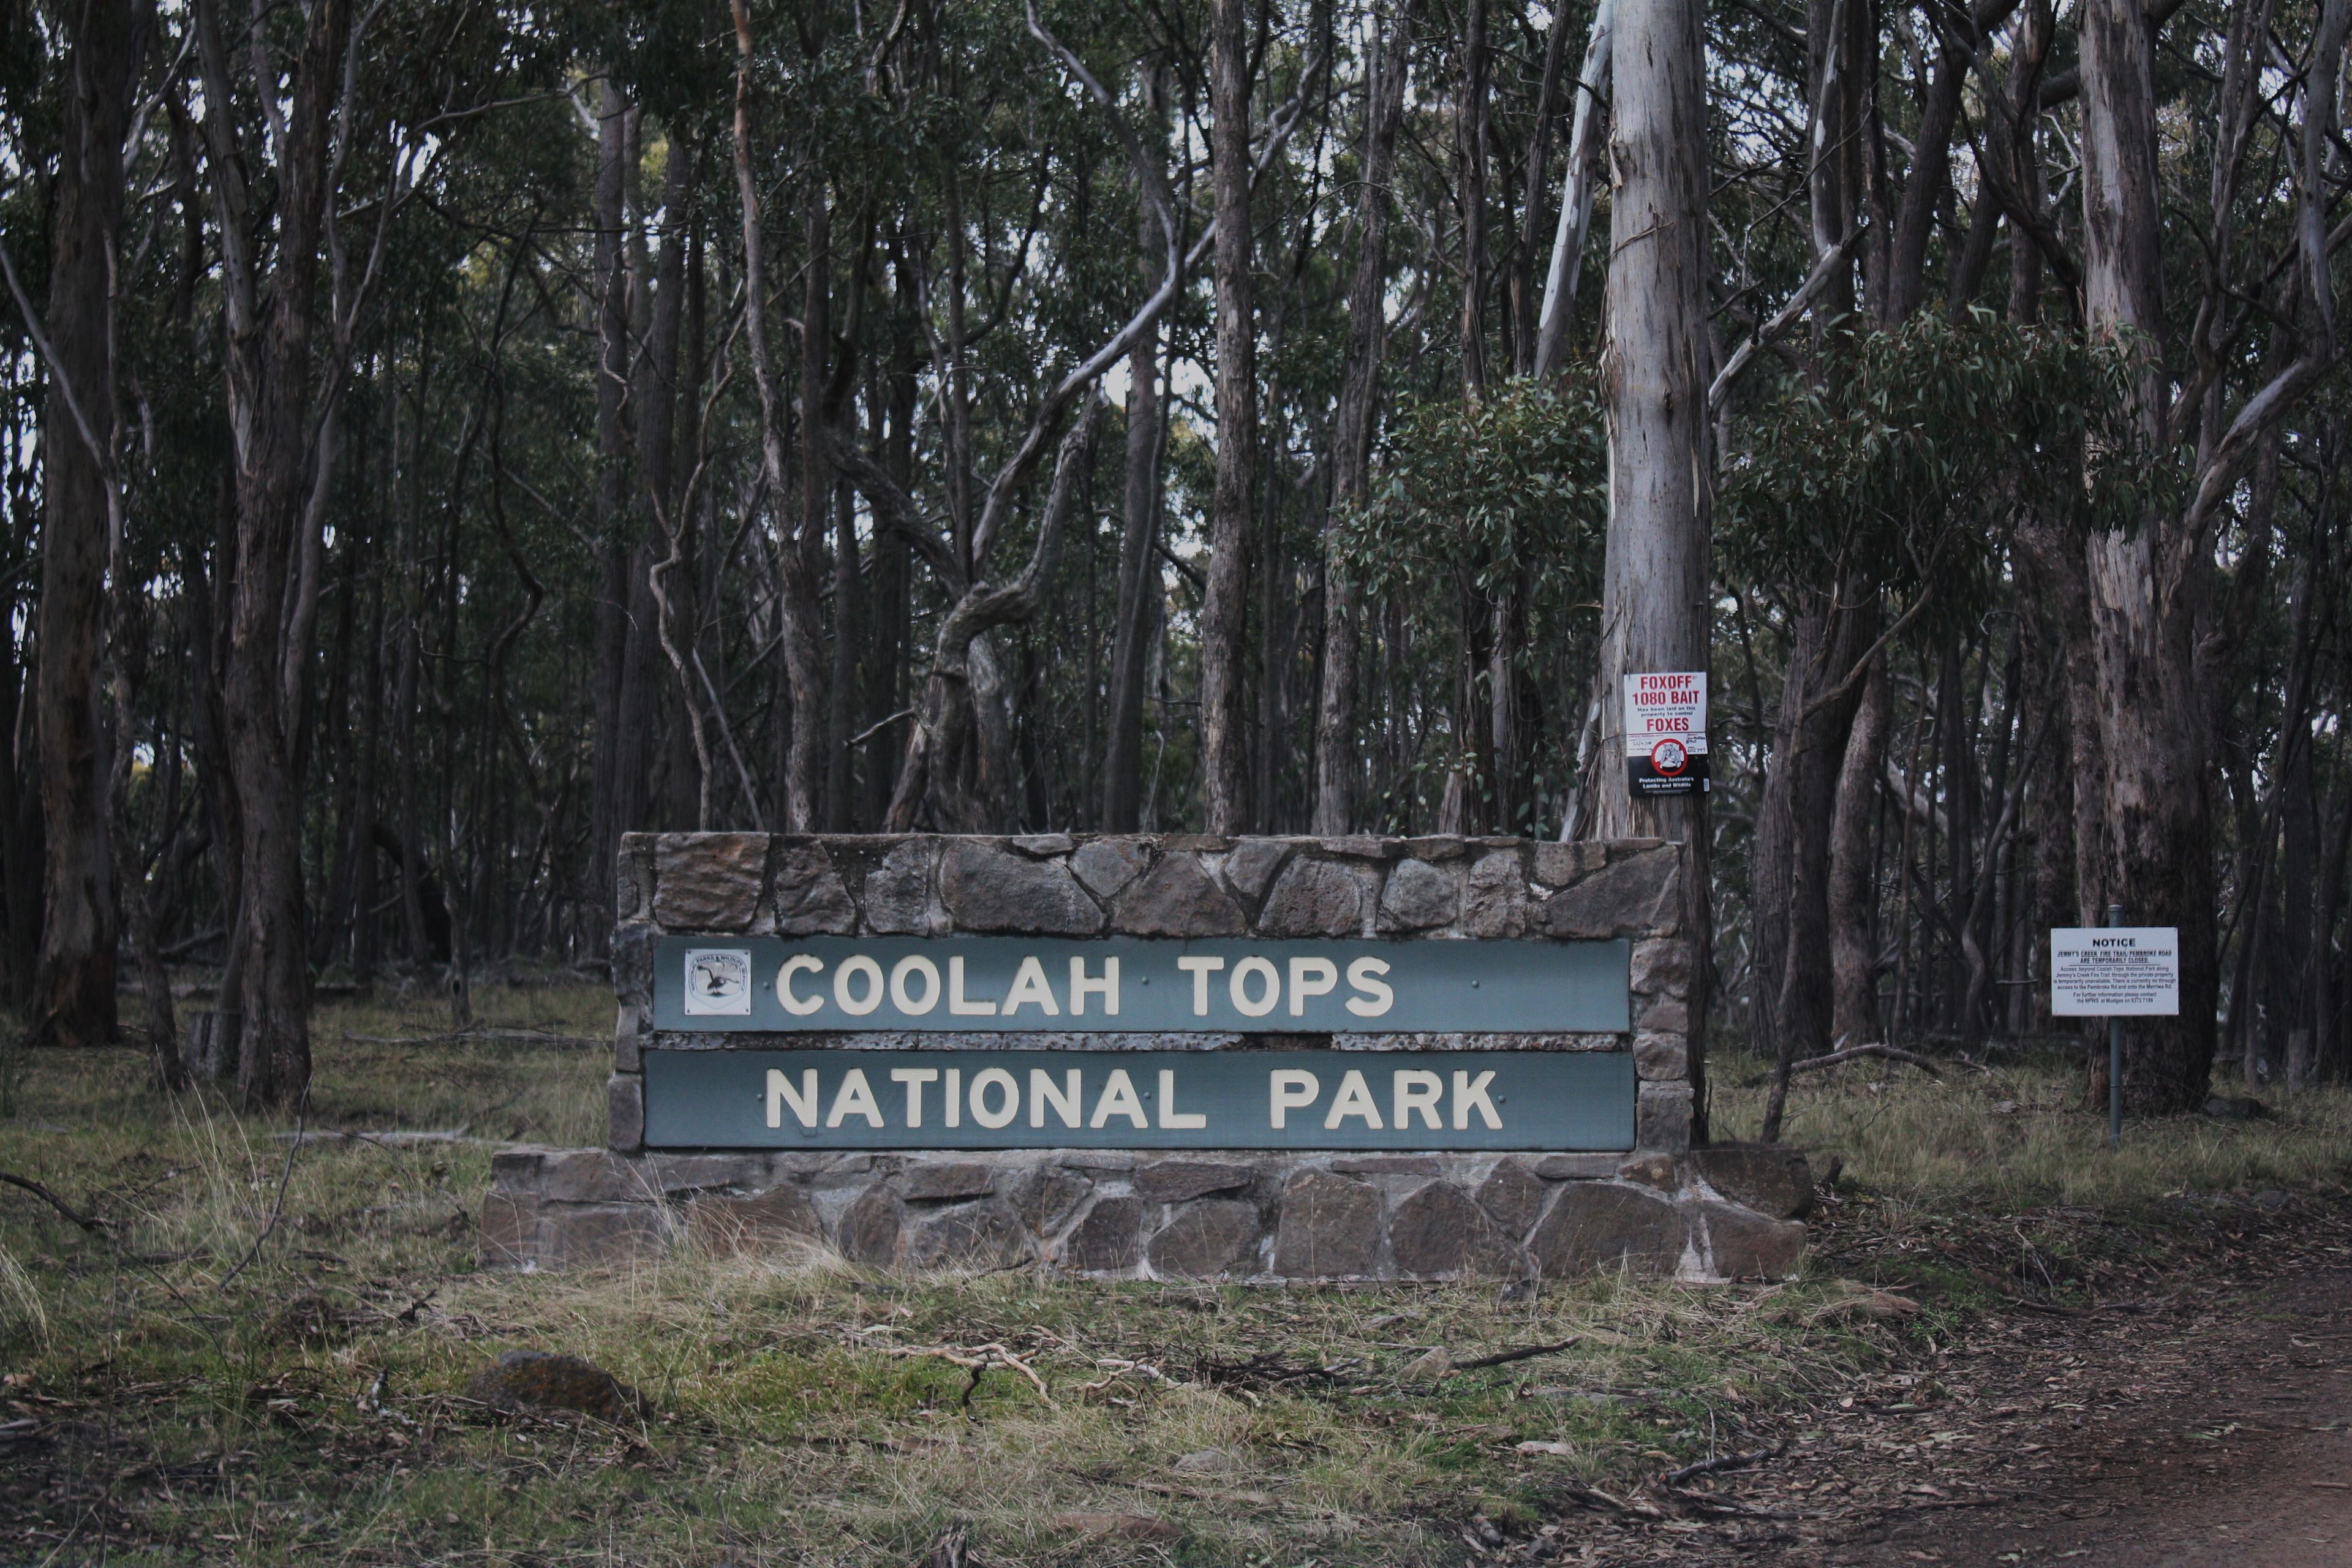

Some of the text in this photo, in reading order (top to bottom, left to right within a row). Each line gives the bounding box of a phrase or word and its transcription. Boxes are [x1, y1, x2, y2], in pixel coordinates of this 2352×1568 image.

[1632, 690, 1700, 706] 1080 BAIT
[1646, 717, 1689, 732] FOXES
[2092, 938, 2136, 947] NOTICE
[721, 956, 743, 966] WILDLIFE
[776, 955, 1394, 1017] COOLAH TOPS
[766, 1068, 1503, 1130] NATIONAL PARK
